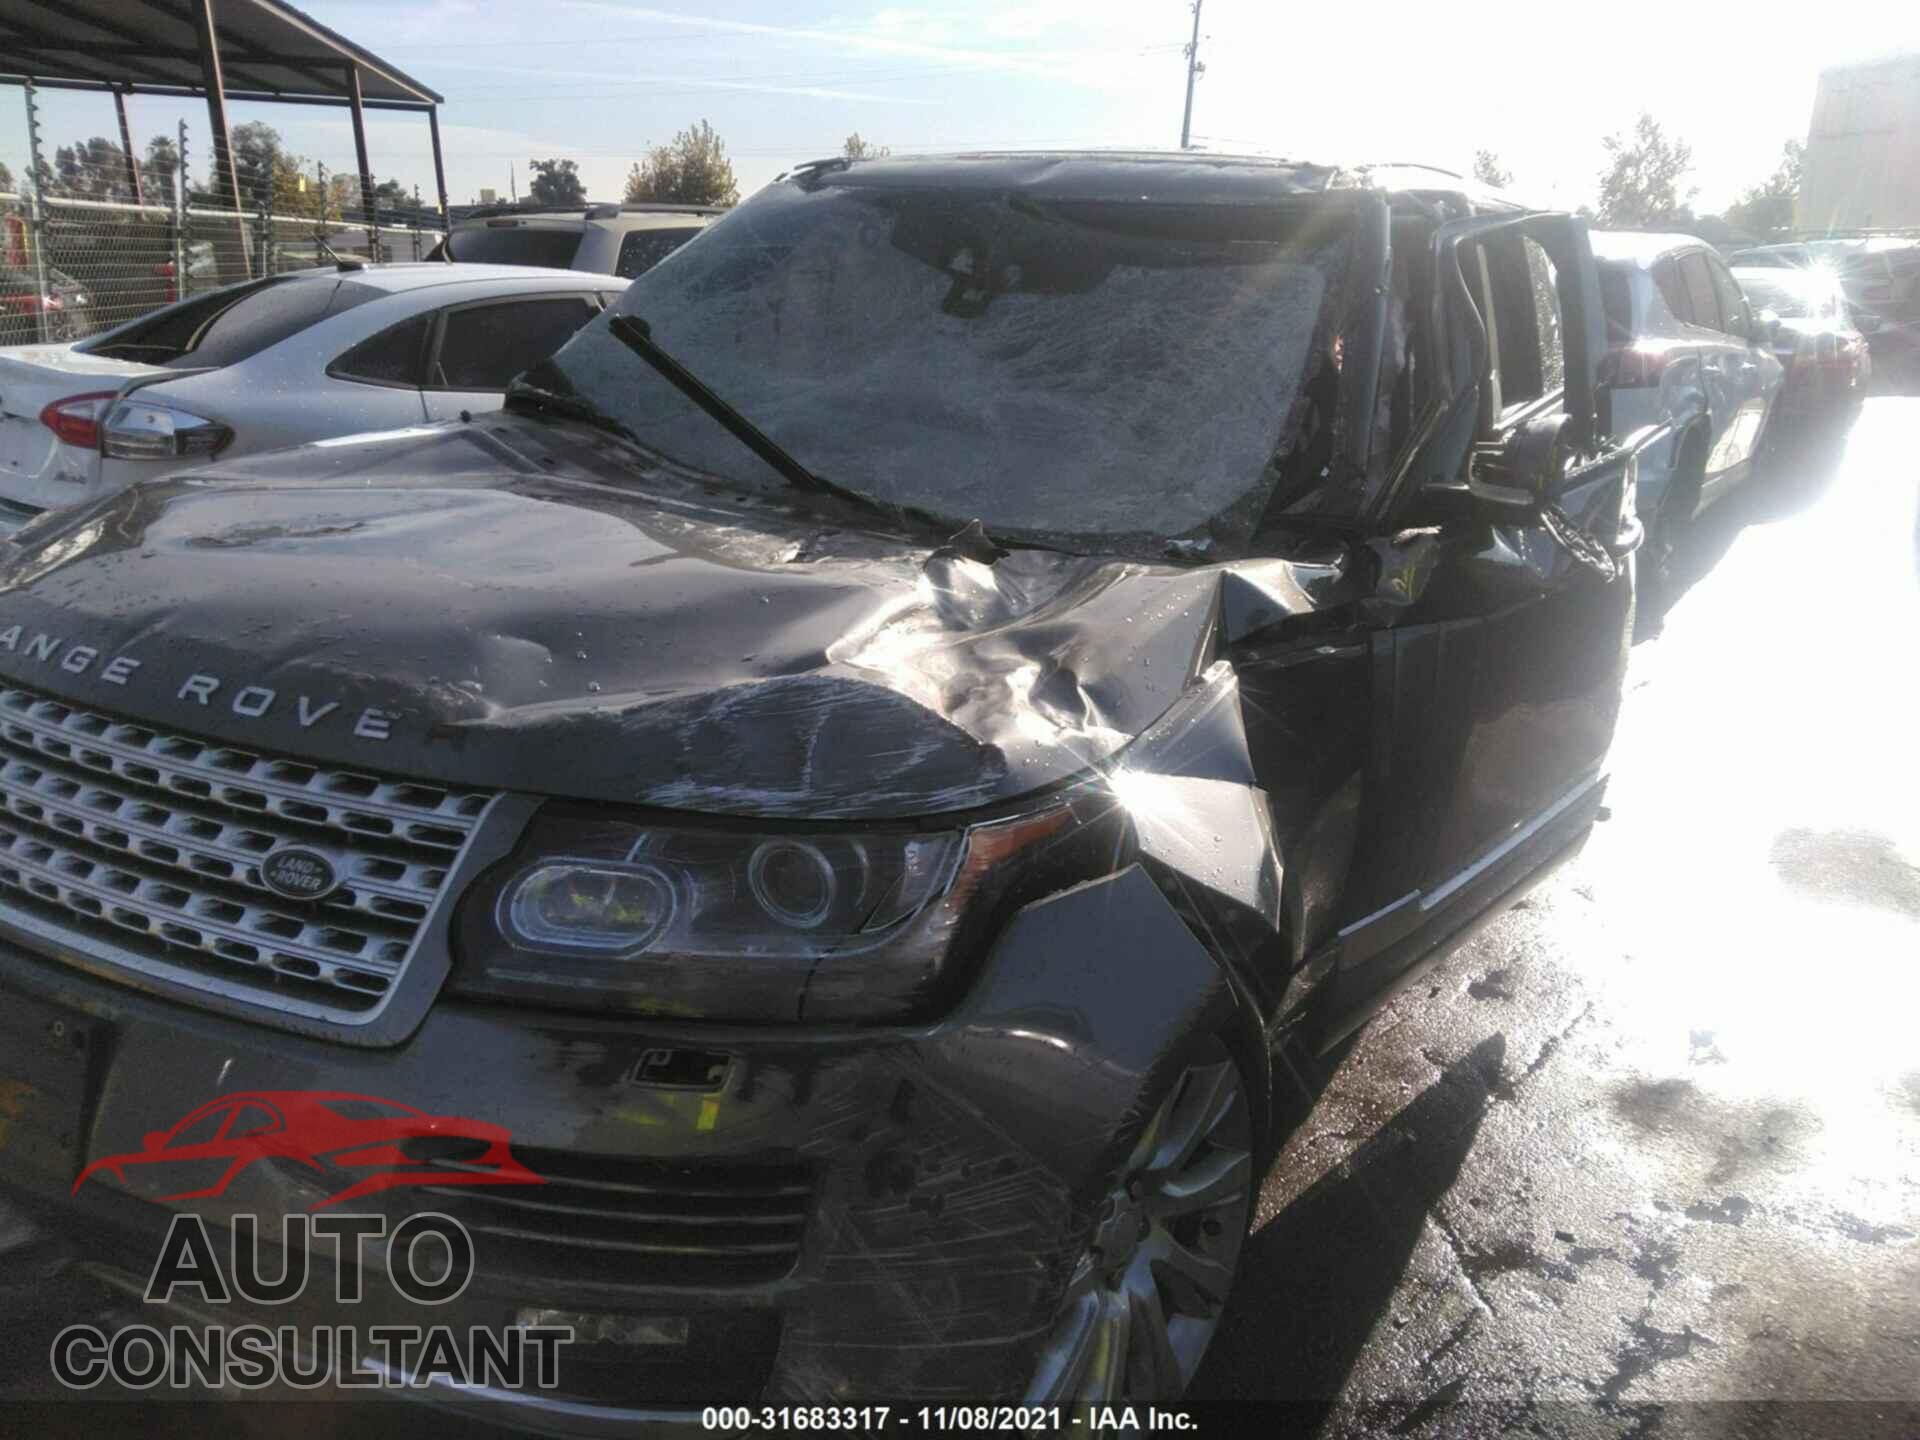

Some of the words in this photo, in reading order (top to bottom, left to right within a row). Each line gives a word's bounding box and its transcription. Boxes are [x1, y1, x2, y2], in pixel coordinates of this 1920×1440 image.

[0, 624, 142, 685] ANGE
[277, 855, 315, 873] LAND
[277, 869, 322, 890] ROVER
